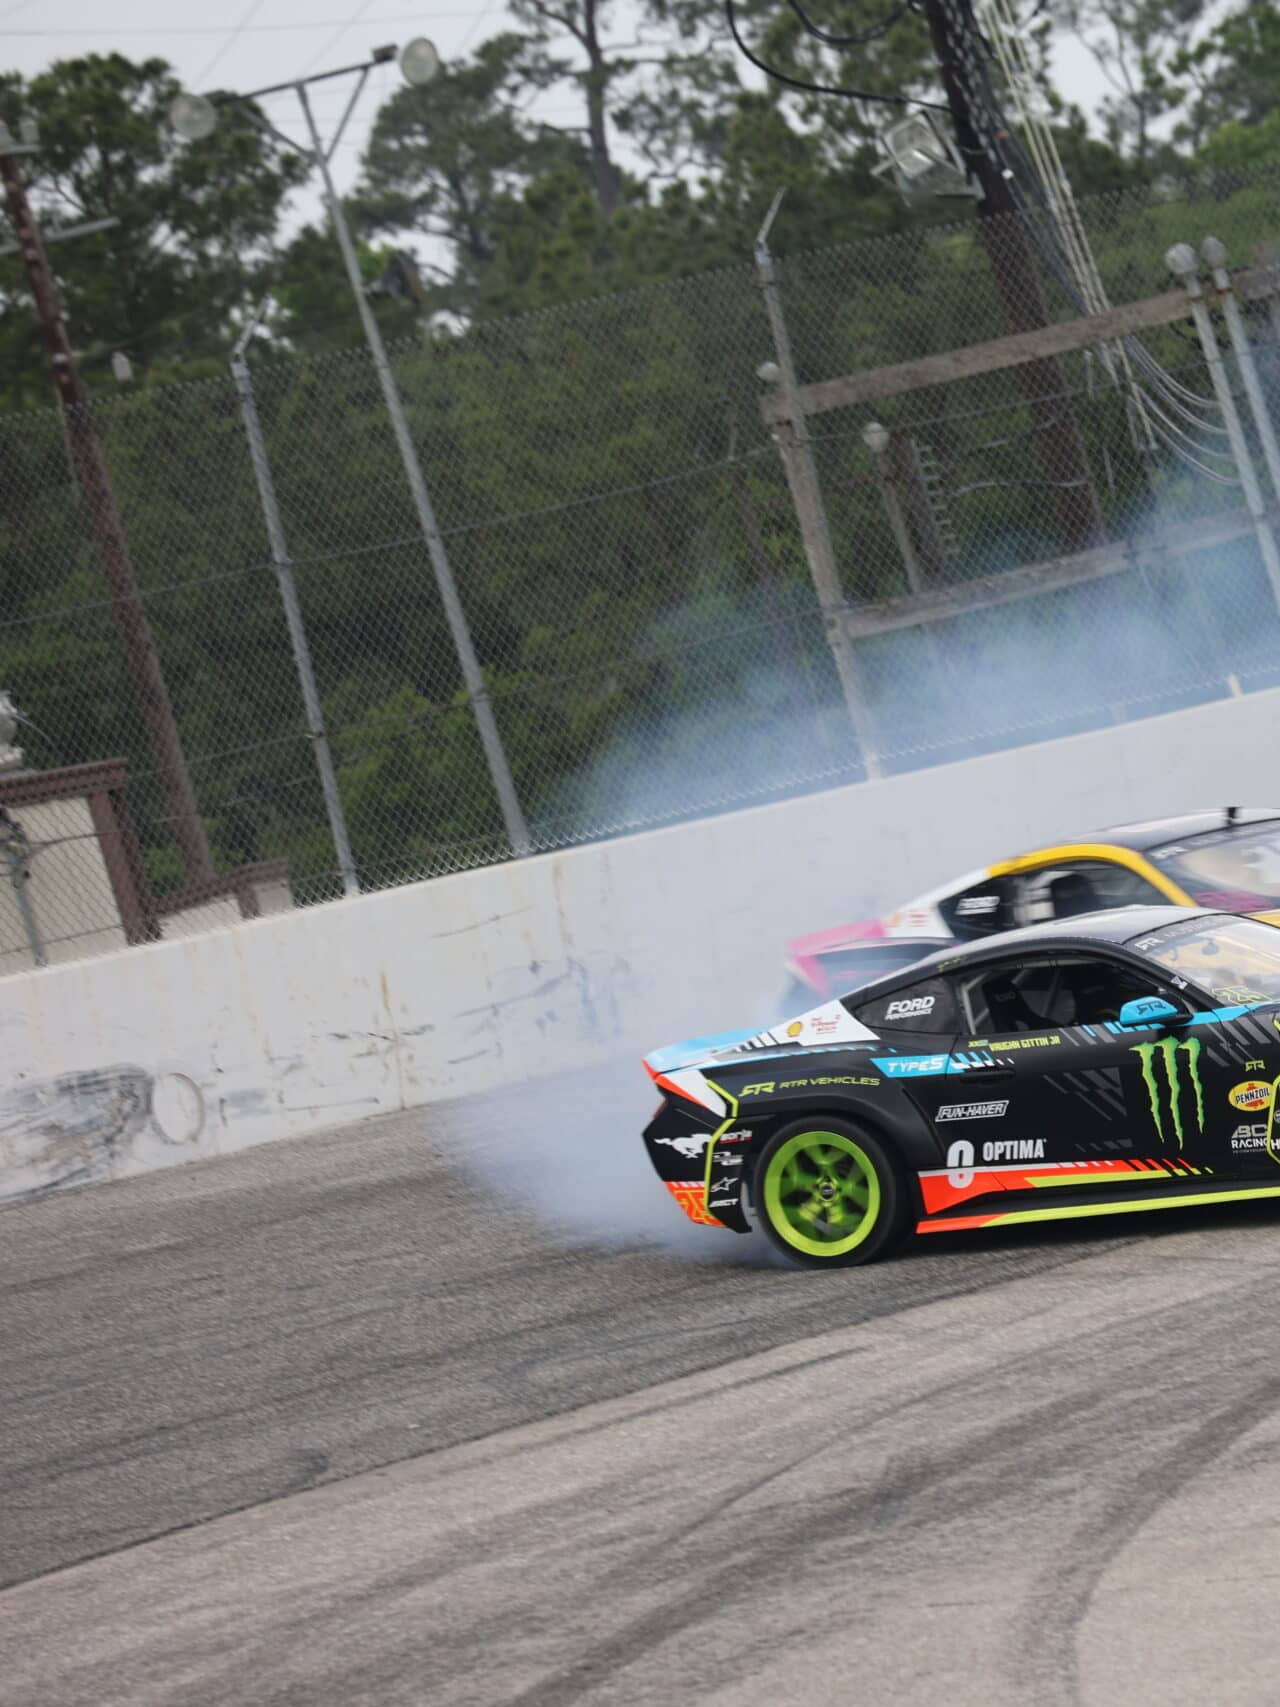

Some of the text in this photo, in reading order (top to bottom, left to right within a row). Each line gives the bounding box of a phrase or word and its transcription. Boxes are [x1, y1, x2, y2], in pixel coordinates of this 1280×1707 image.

[887, 996, 935, 1015] FORD
[810, 1076, 881, 1086] VEHICLES
[1235, 1088, 1270, 1105] PENNZOIL
[940, 1103, 1004, 1119] FUN-HAVER
[982, 1138, 1045, 1162] OPTIMA
